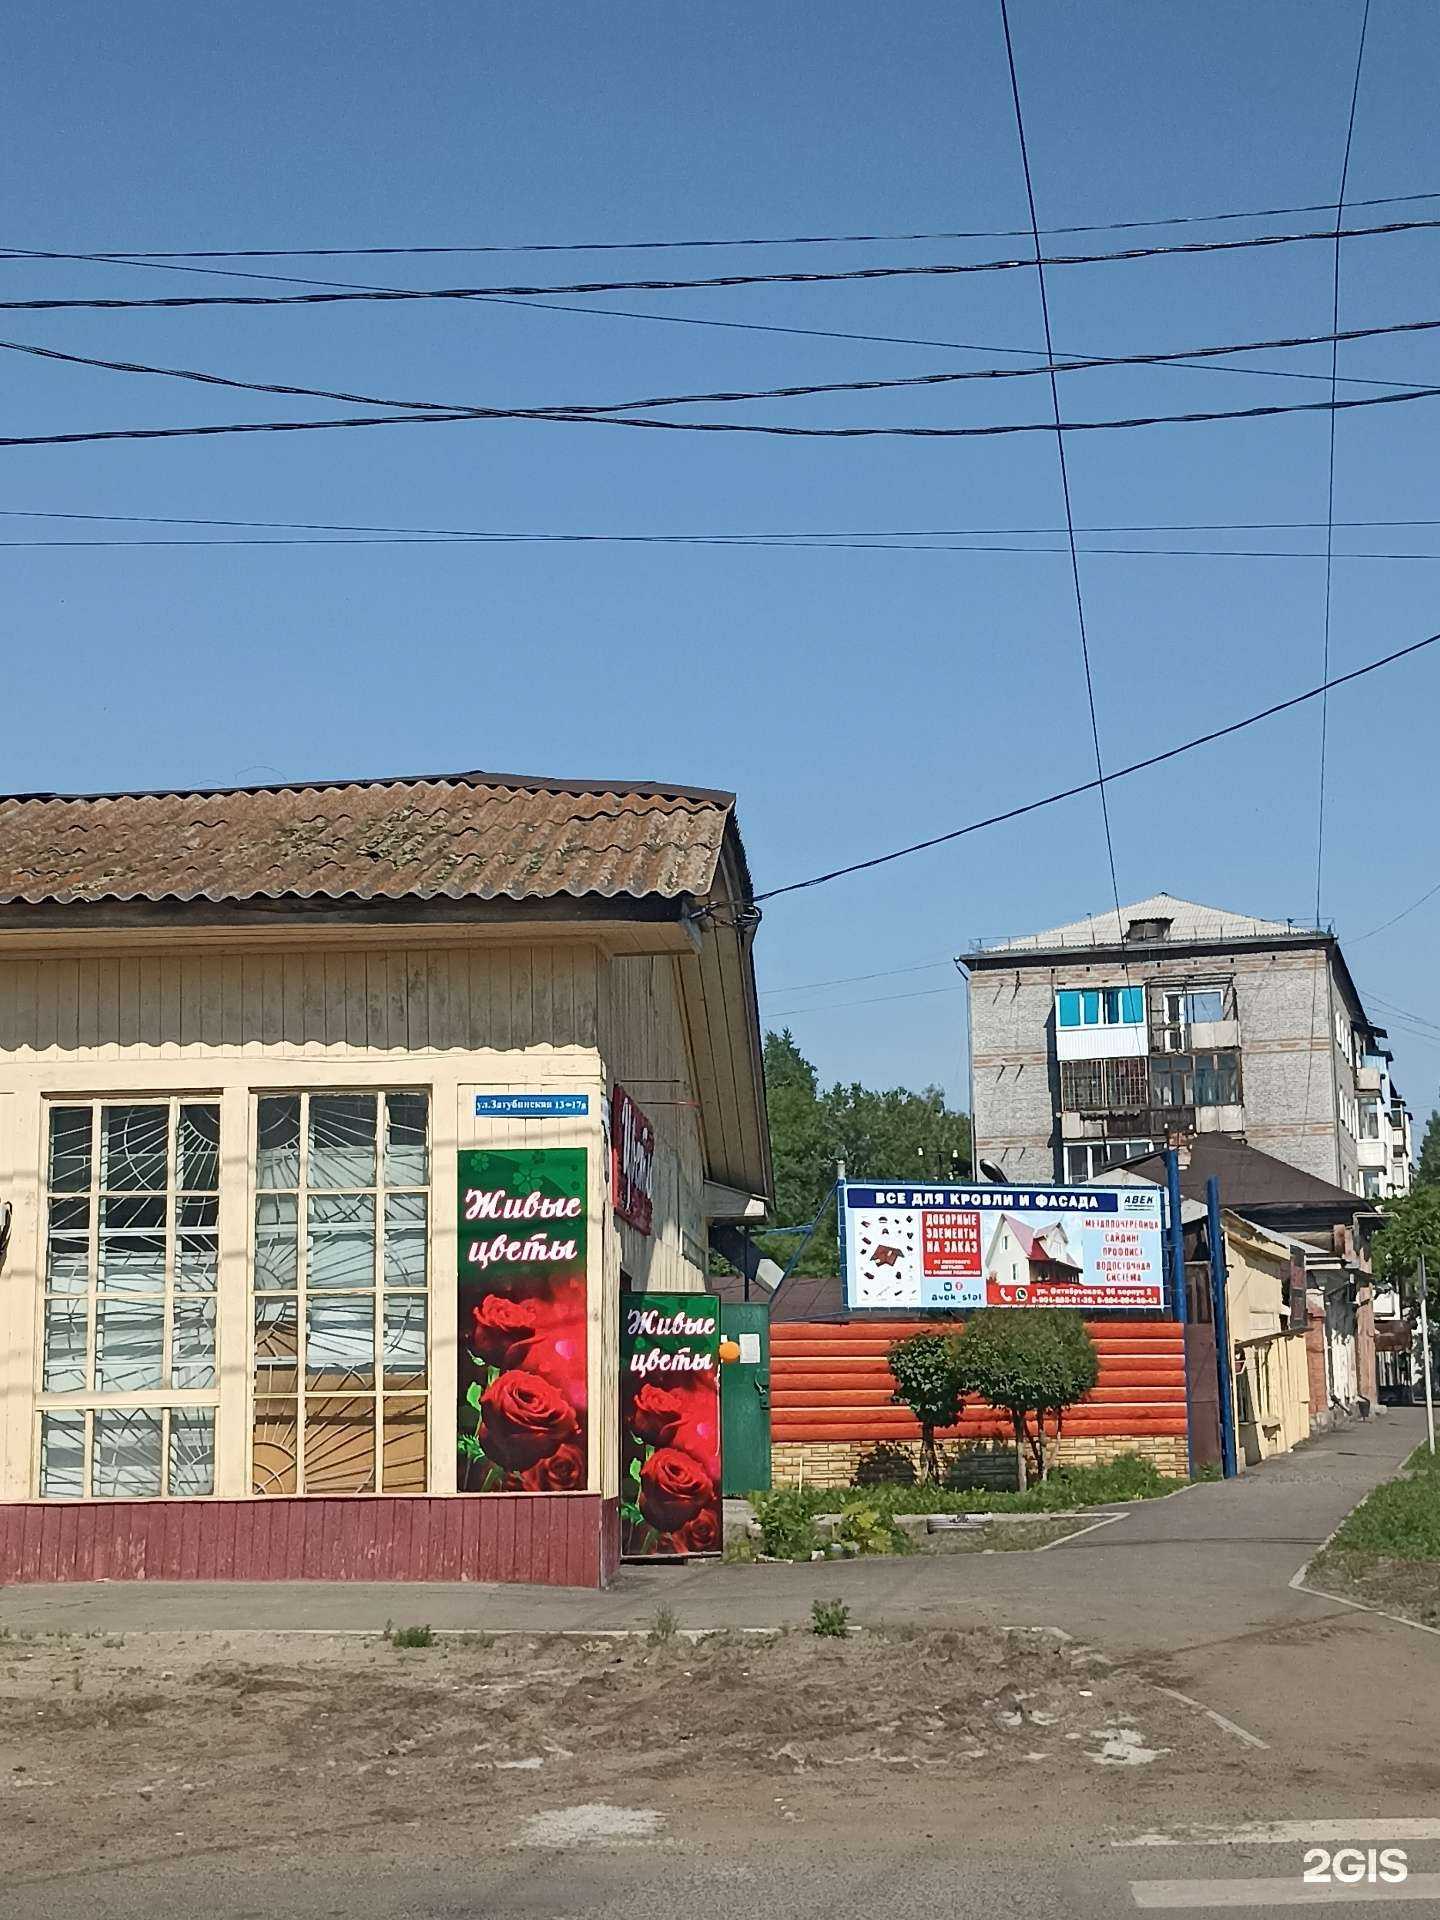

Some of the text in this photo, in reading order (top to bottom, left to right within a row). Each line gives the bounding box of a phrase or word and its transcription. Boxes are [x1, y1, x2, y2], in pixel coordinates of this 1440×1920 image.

[465, 1188, 582, 1220] Живые
[875, 1192, 1099, 1209] ВСЕ ДЛЯ КРОВЛИ И ФАСАДА
[1124, 1195, 1154, 1204] АВЕК
[925, 1213, 977, 1226] ДОБОРНЫЕ
[926, 1228, 978, 1240] ЭЛЕМЕНТЫ
[468, 1233, 578, 1269] цветы
[926, 1241, 978, 1253] НА ЗАКАЗ
[1106, 1273, 1142, 1282] СИСТЕМА
[627, 1308, 716, 1336] Живые
[630, 1347, 714, 1379] цветы
